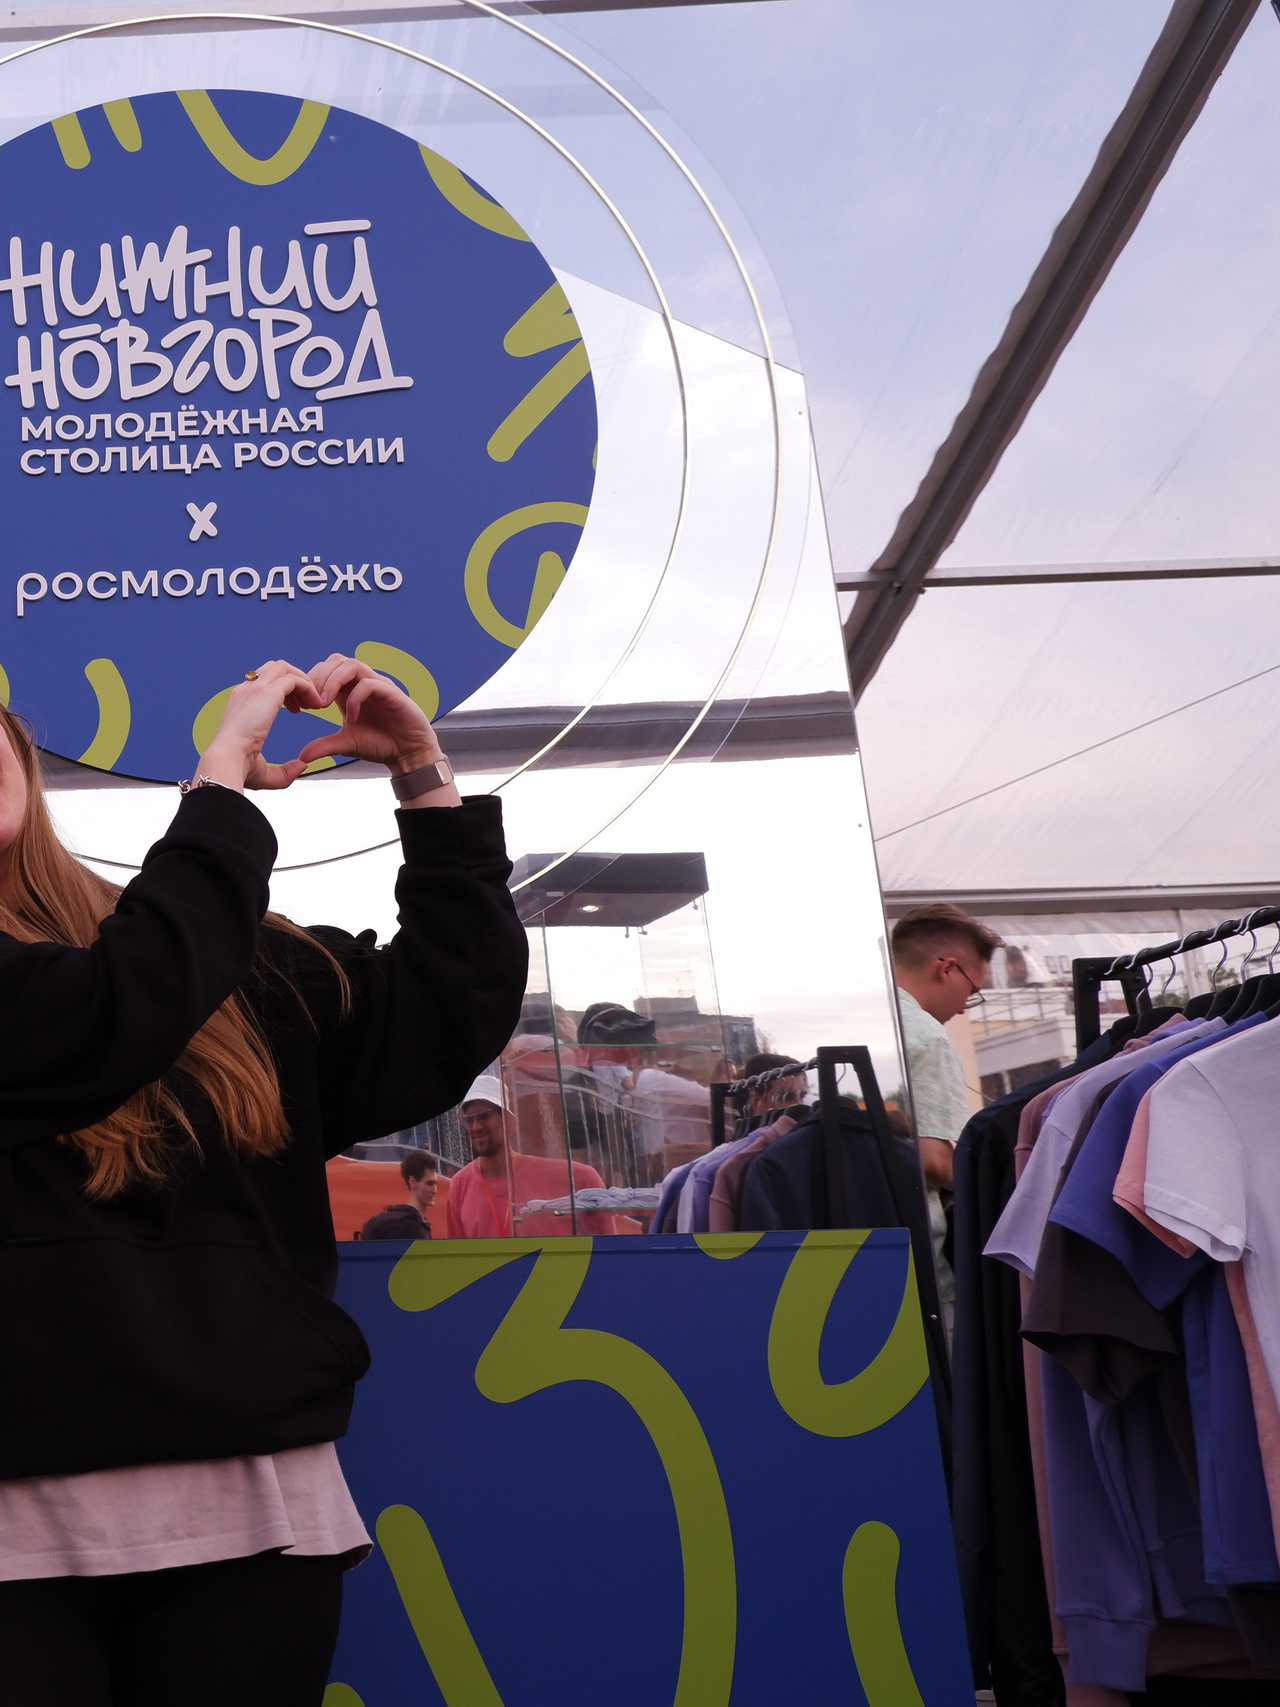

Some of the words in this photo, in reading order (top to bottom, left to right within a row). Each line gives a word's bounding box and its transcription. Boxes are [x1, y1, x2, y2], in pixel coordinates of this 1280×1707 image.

[4, 308, 415, 411] НОВГОРОД
[20, 404, 325, 442] МОЛОДЁЖНАЯ
[19, 443, 222, 475] СТОЛИЦА
[233, 436, 406, 469] РОССИИ
[16, 556, 404, 618] росмолодёжь
